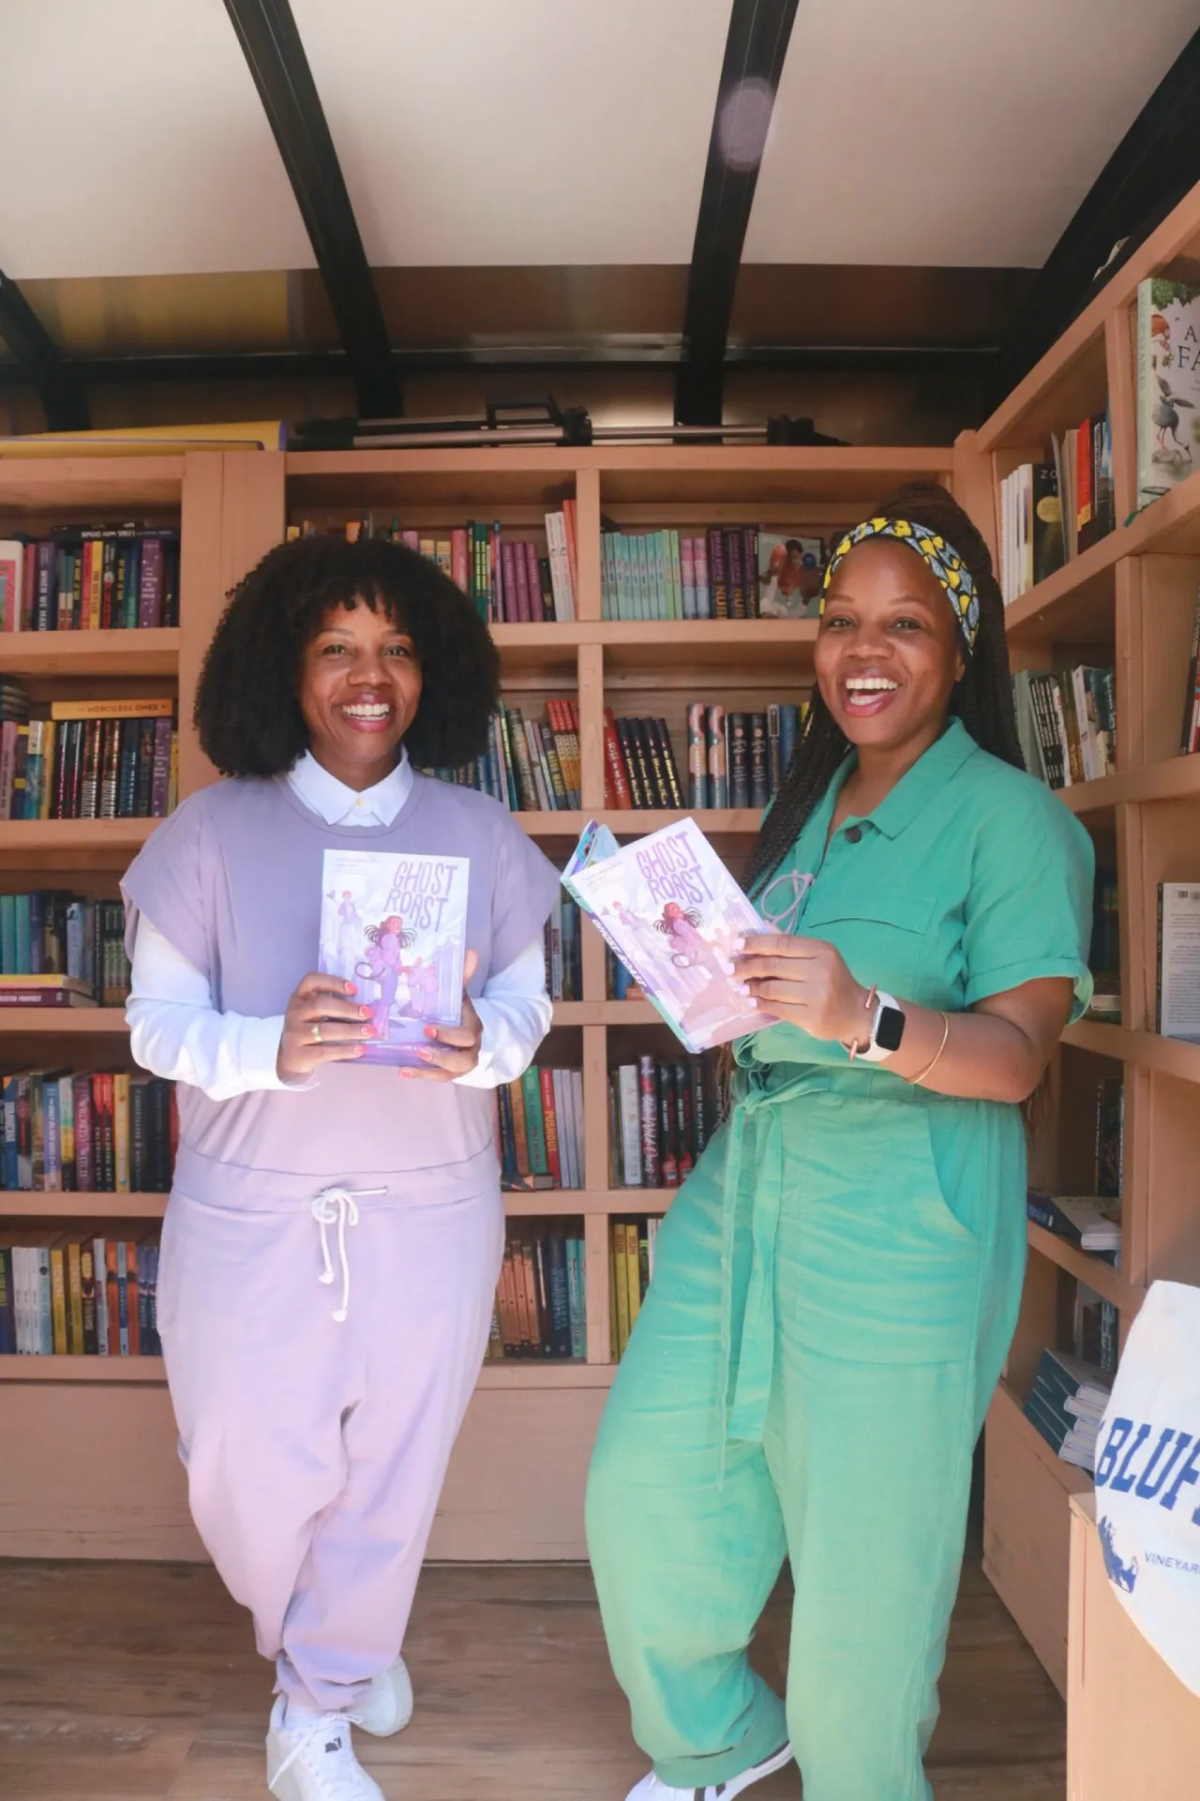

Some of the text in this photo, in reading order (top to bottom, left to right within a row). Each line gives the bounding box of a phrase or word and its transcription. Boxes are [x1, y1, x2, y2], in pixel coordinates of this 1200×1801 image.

[39, 570, 48, 594] WHEN
[39, 595, 48, 608] WE
[636, 831, 698, 880] GHOST
[393, 860, 458, 896] GHOST
[646, 865, 714, 905] ROAST
[383, 889, 450, 932] ROAST
[544, 1110, 557, 1152] PUSHOUT
